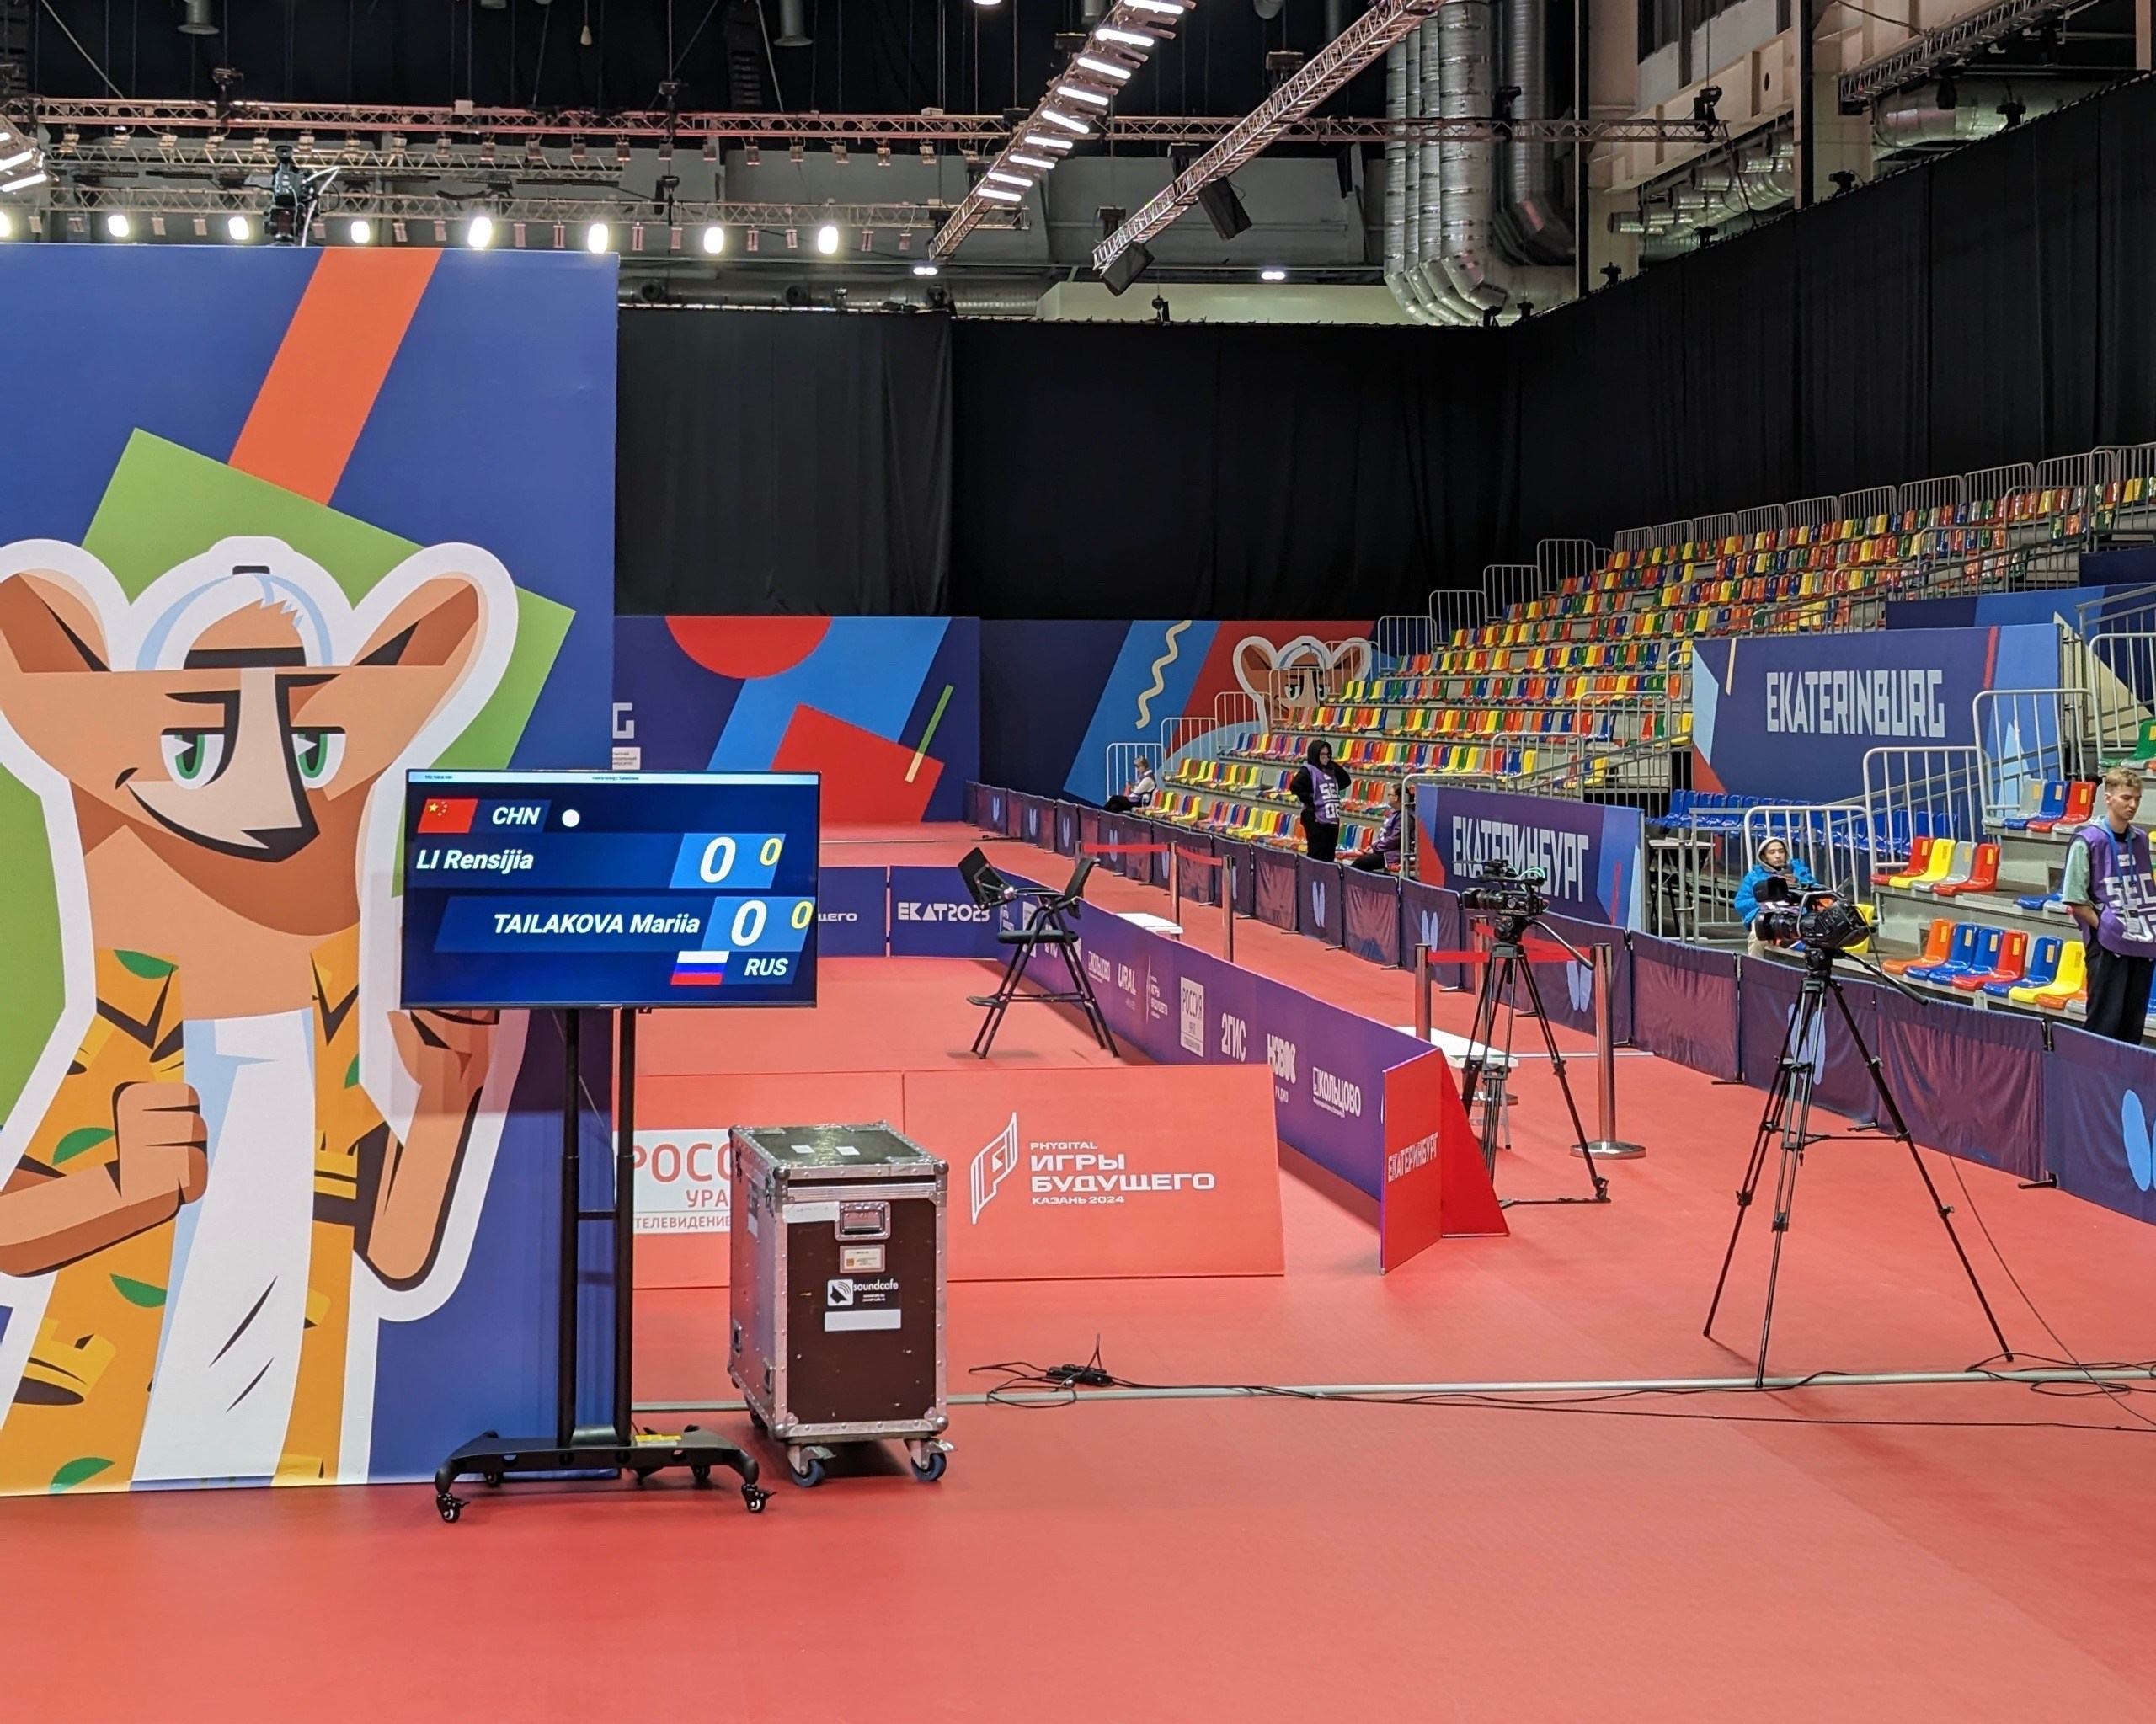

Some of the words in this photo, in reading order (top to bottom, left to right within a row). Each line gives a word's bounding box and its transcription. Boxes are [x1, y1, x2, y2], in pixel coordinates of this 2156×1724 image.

[1766, 670, 1945, 738] EKATERINBURG
[1319, 782, 1338, 800] SE
[492, 807, 541, 825] CHN
[416, 850, 439, 869] LI
[443, 849, 534, 874] Rensijia
[699, 836, 736, 883] 0
[760, 837, 782, 866] 0
[1453, 815, 1589, 903] ЕКАТЕРИНБУРГ
[791, 901, 814, 929] 0
[898, 902, 990, 922] EKAT2023
[494, 914, 623, 934] TAILAKOVA
[629, 914, 701, 934] Mariia
[730, 900, 767, 947] 0
[744, 958, 788, 976] RUS
[1221, 1012, 1246, 1062] 2ГИС
[1030, 1141, 1097, 1150] PHYGITAL
[1031, 1154, 1125, 1172] ИГРЫ
[1032, 1173, 1215, 1193] БУДУЩЕГО
[1032, 1196, 1086, 1205] КАЗАНЬ
[1089, 1196, 1125, 1204] 2024
[853, 1278, 899, 1292] soundcafe
